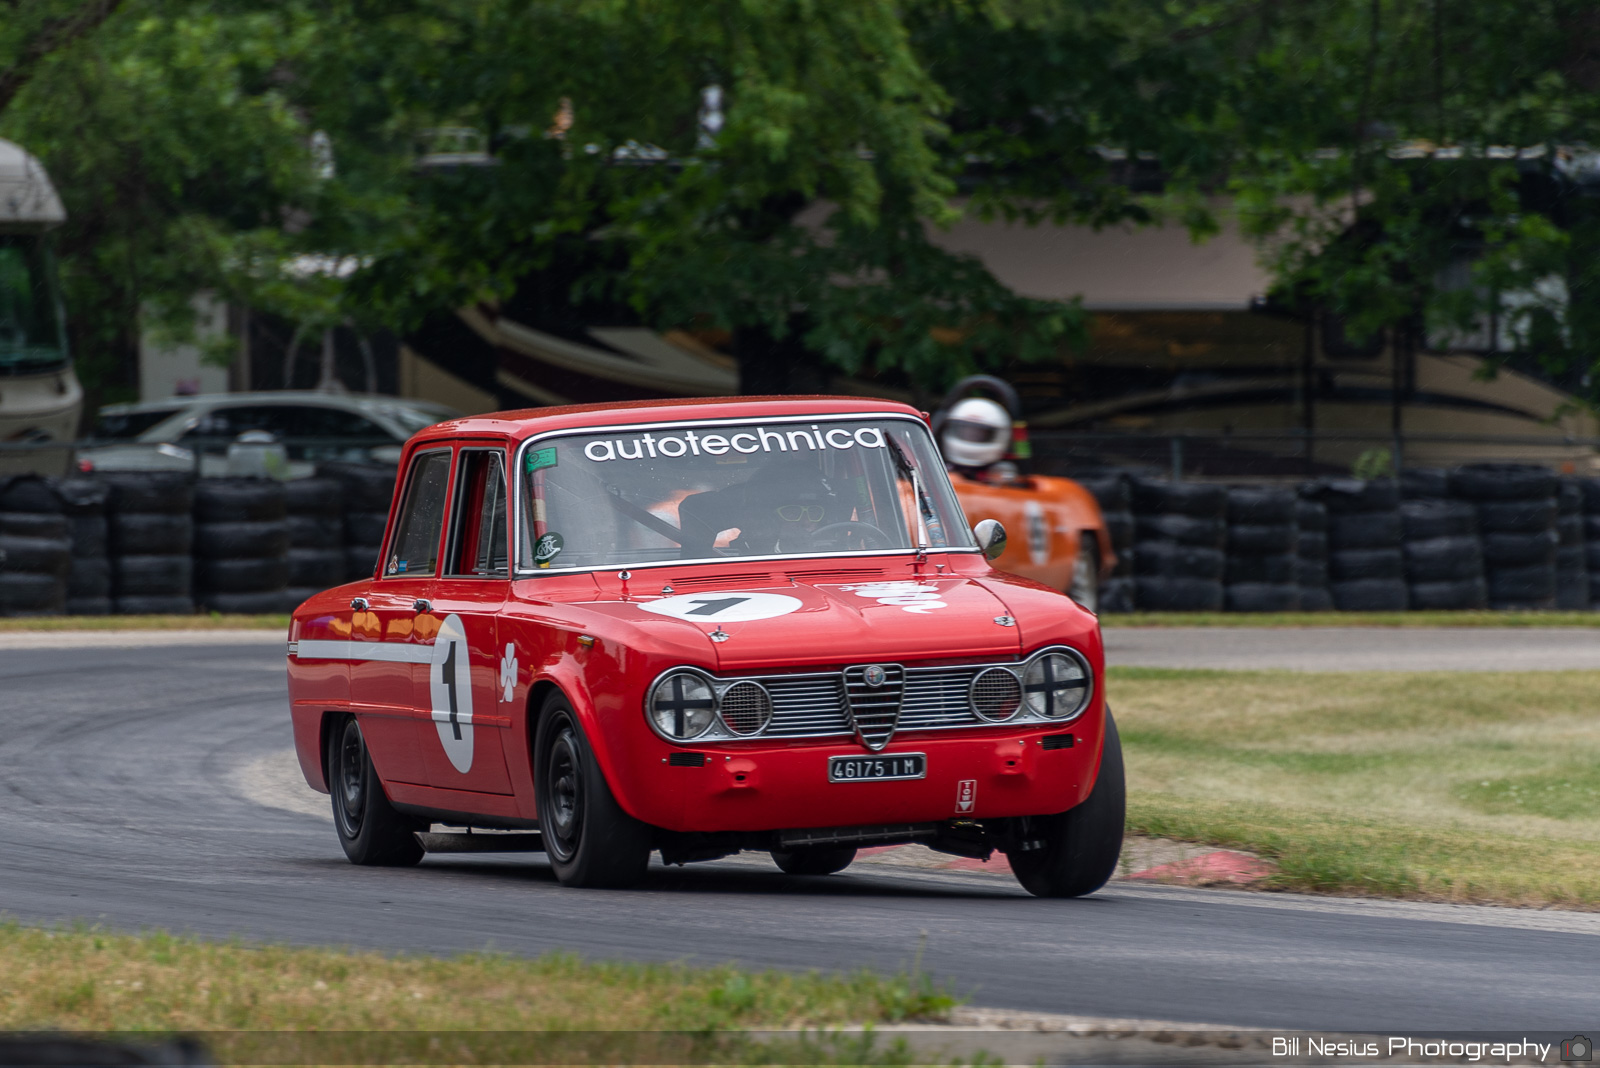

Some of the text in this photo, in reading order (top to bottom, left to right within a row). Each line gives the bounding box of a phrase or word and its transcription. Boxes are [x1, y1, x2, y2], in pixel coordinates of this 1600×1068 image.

[584, 424, 886, 462] autotechnica
[685, 597, 753, 616] 1
[442, 641, 463, 740] 1
[834, 761, 885, 778] 46175
[961, 781, 971, 801] TOW
